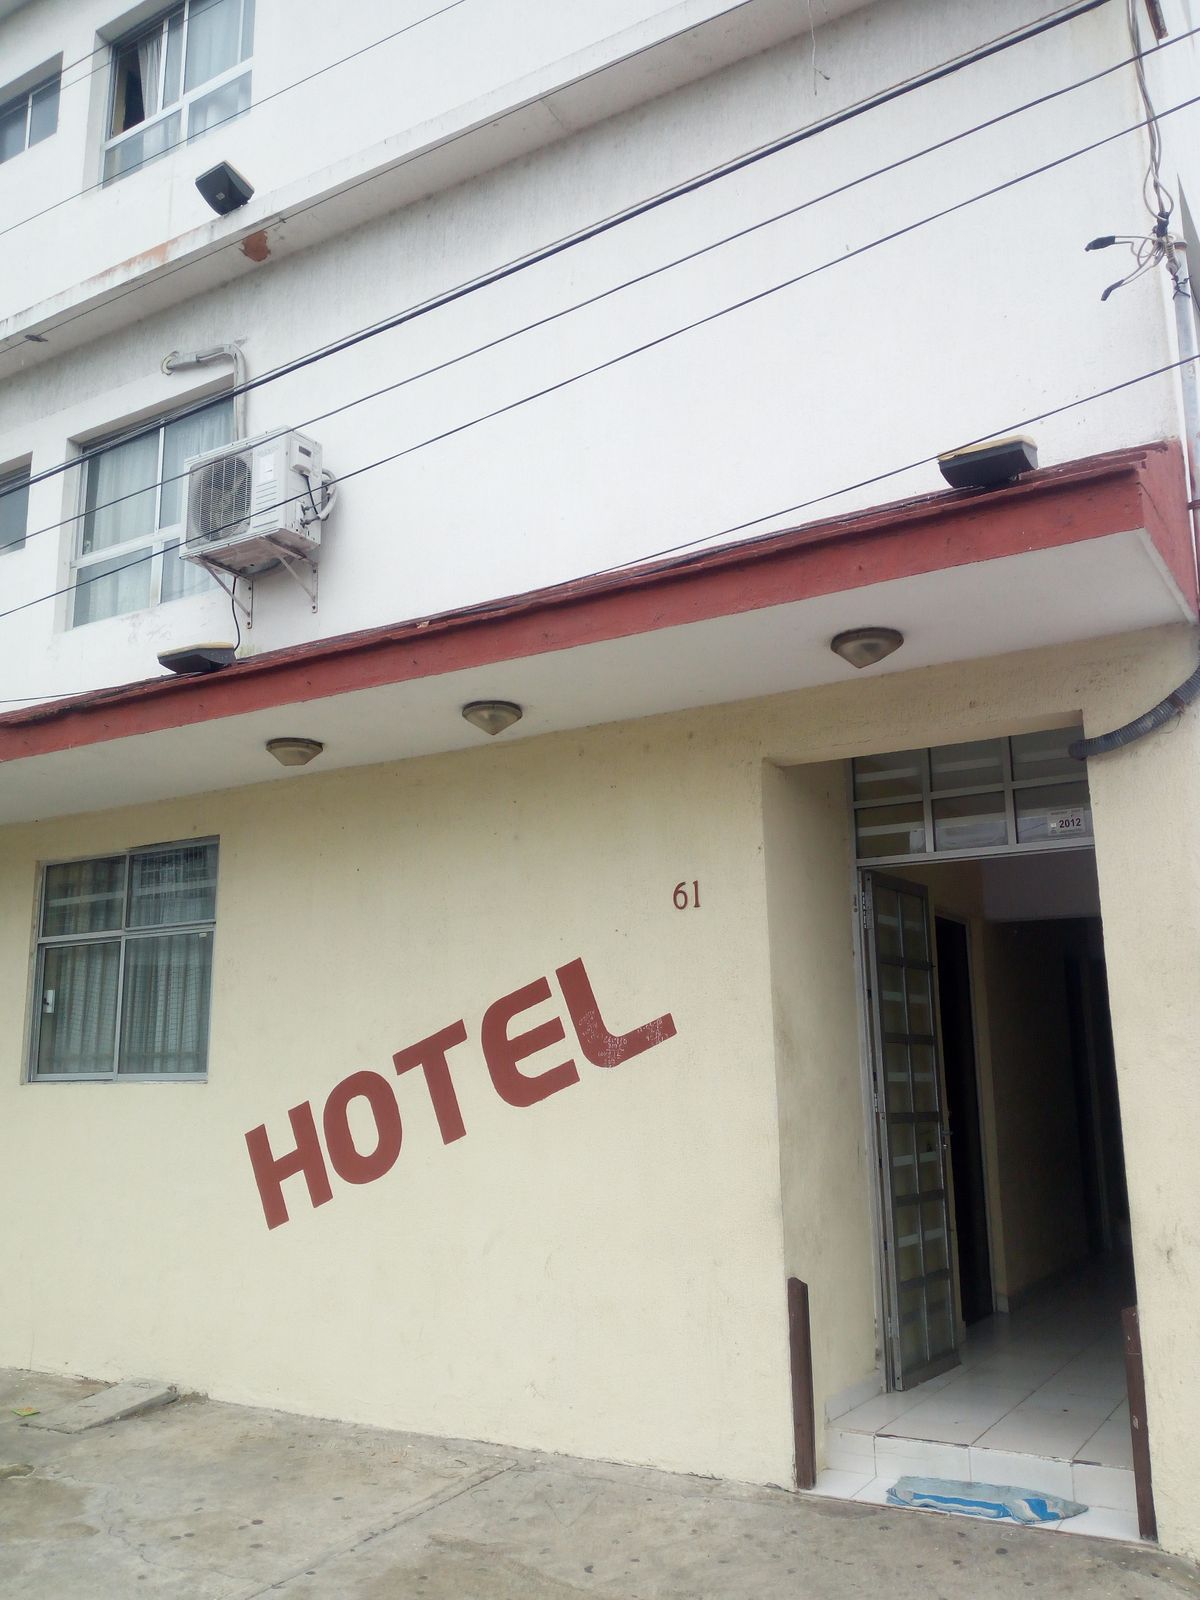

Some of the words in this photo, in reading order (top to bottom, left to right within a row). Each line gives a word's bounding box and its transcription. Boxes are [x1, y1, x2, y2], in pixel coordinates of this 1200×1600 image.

[1058, 817, 1081, 829] 2012
[673, 879, 701, 910] 61
[244, 957, 678, 1231] HOTEL
